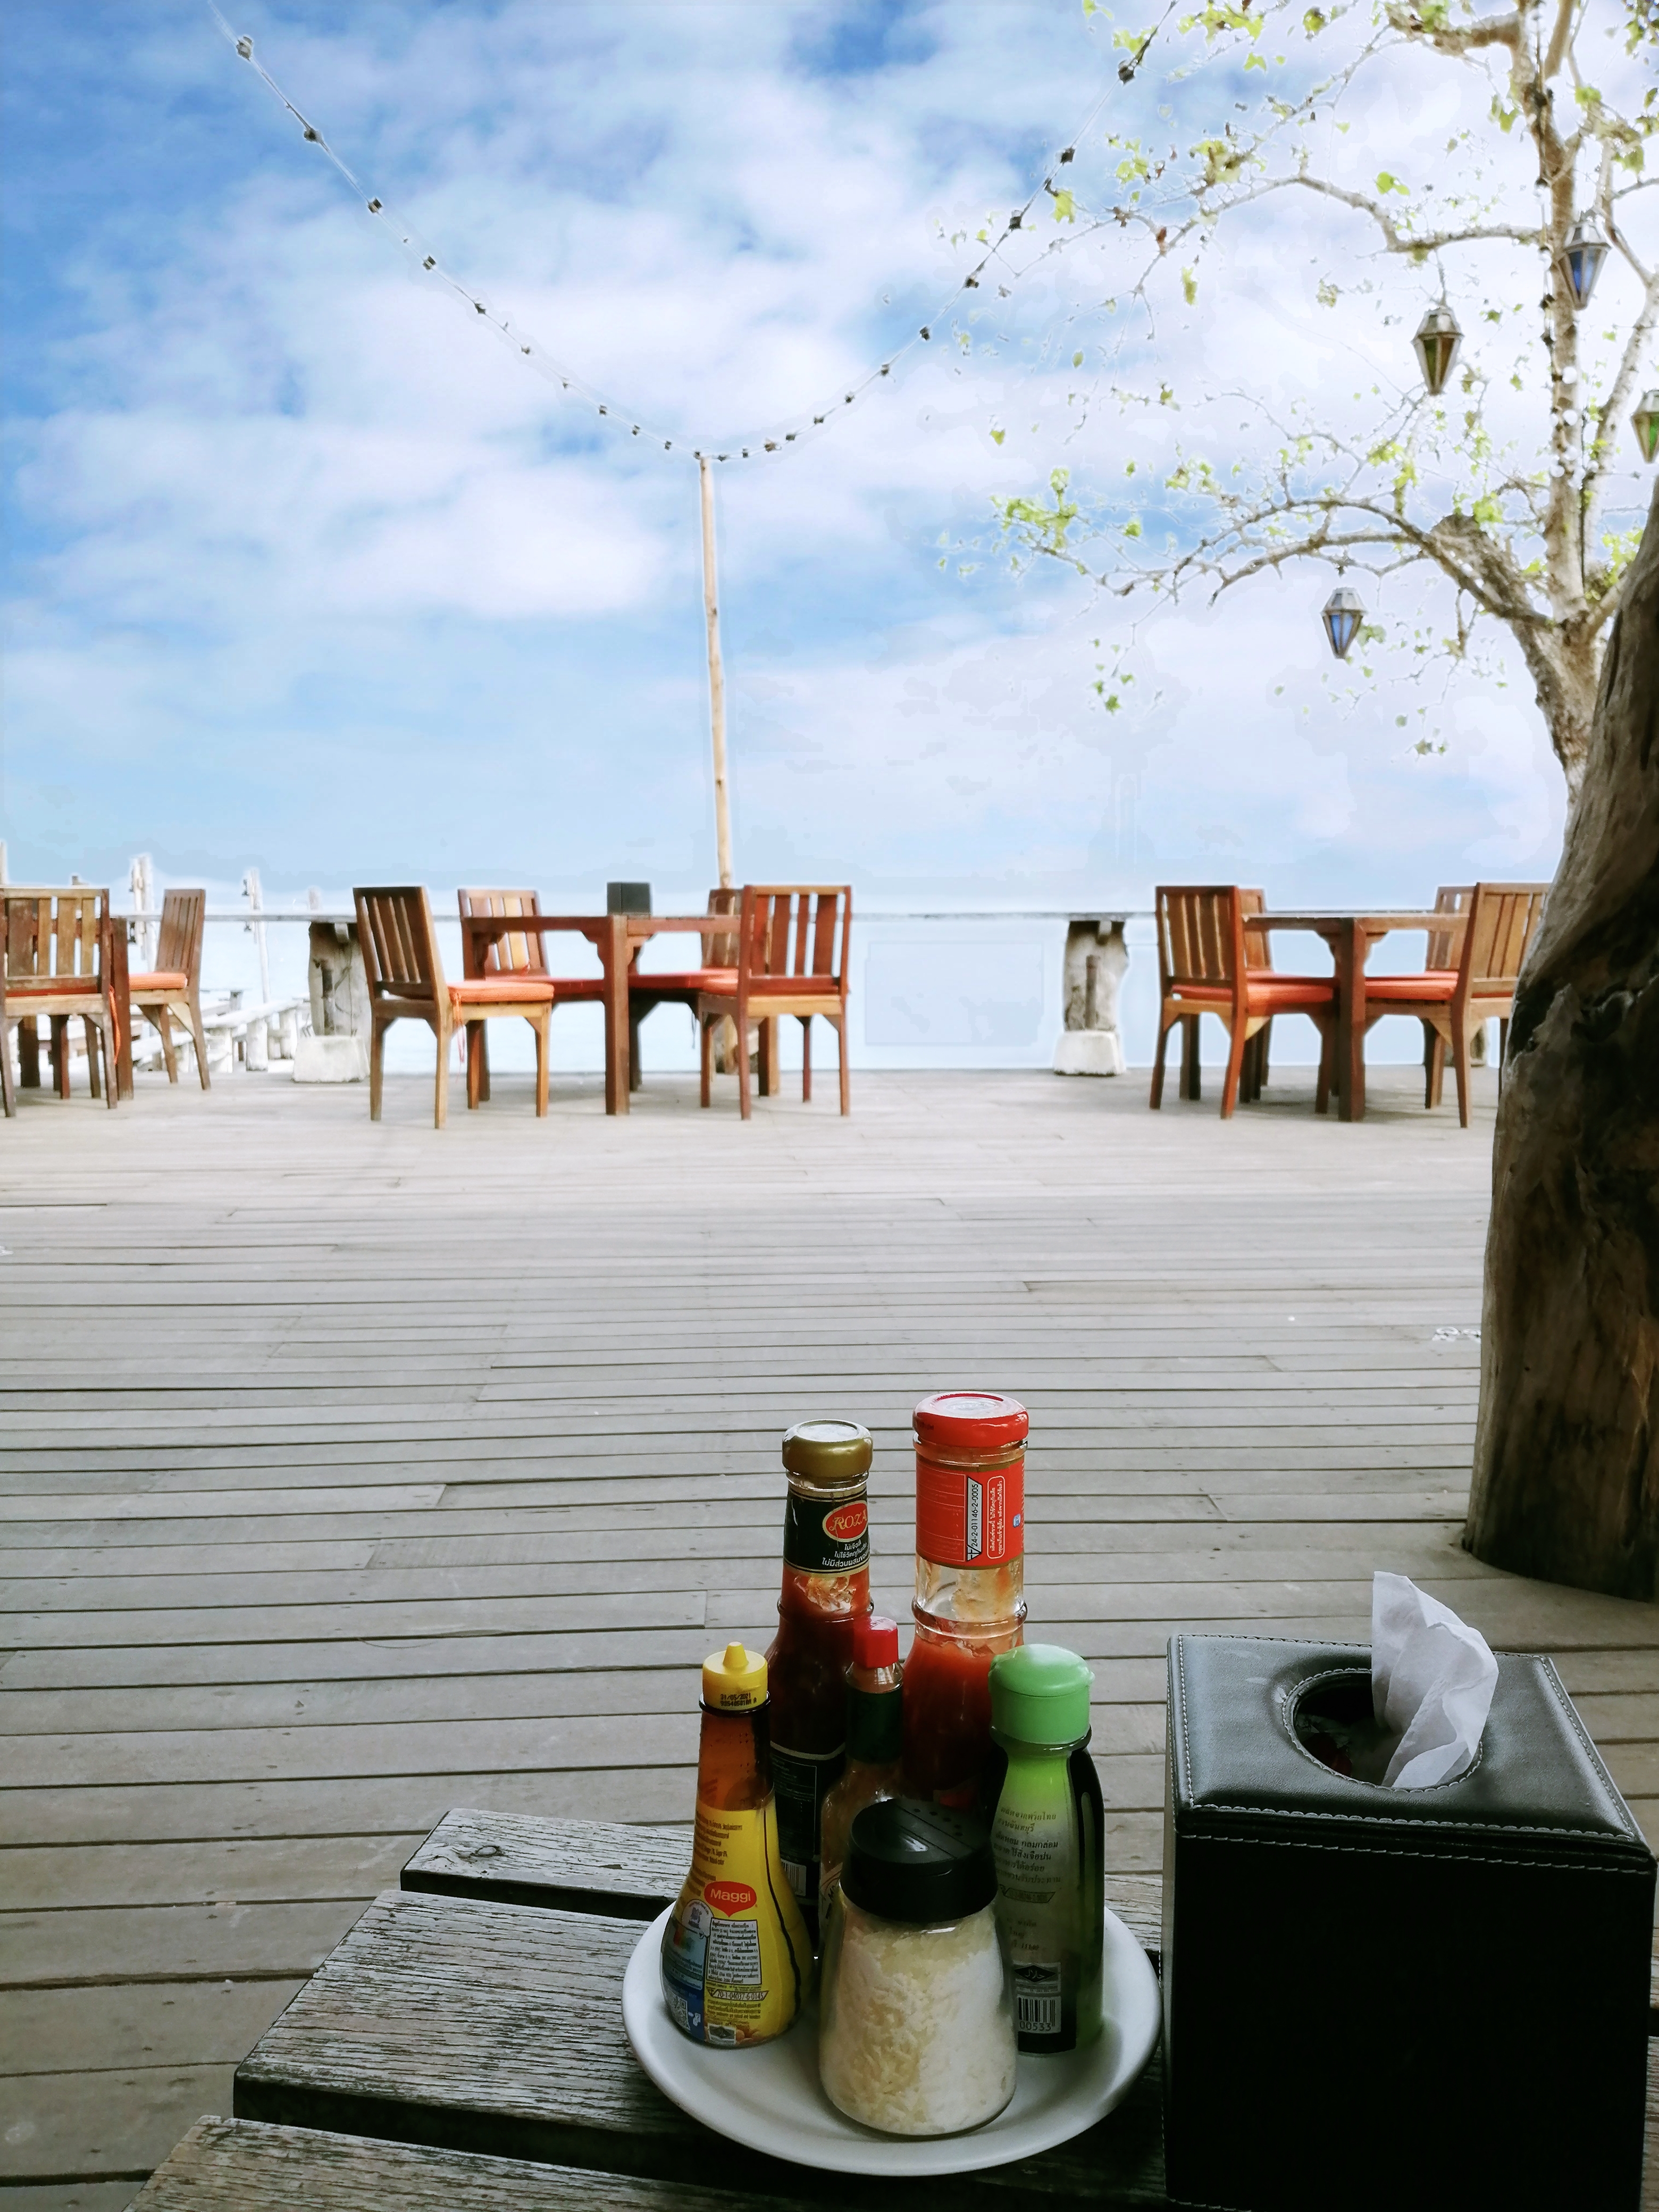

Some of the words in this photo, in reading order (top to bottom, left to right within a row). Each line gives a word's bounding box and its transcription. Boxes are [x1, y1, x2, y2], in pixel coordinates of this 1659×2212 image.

[829, 1508, 867, 1531] ROZA
[710, 1888, 751, 1903] Maggi
[1019, 2021, 1051, 2031] 00533
